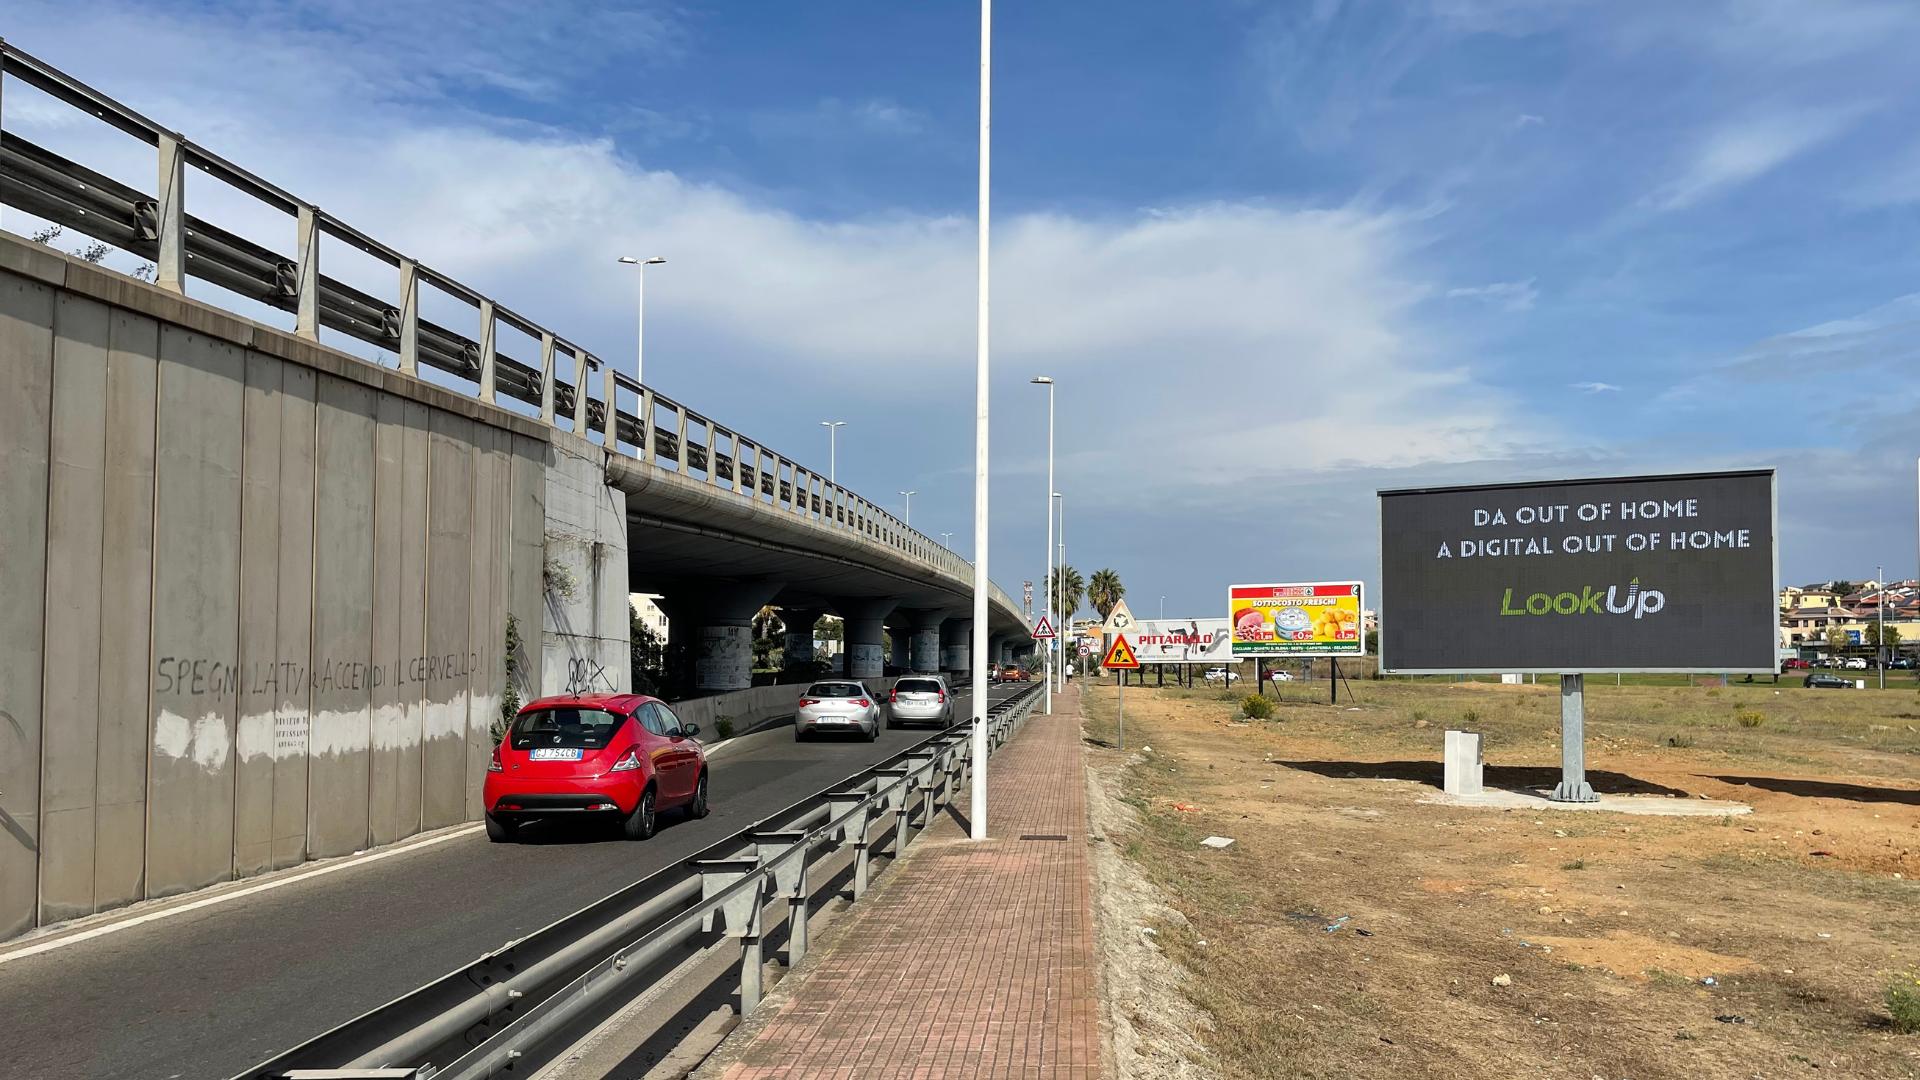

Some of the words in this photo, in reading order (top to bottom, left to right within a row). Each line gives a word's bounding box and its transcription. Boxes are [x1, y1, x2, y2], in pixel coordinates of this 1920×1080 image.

[1474, 508, 1507, 526] DA
[1516, 505, 1568, 524] OUT
[1577, 503, 1611, 521] OF
[1621, 499, 1698, 520] HOME
[1436, 541, 1452, 558] A
[1460, 537, 1554, 557] DIGITAL
[1562, 534, 1617, 553] OUT
[1625, 533, 1660, 551] OF
[1671, 529, 1750, 550] HOME
[1500, 577, 1666, 620] LookUp
[156, 657, 244, 702] SPEGNI
[252, 661, 278, 695] LA
[321, 658, 387, 694] ACCENDI
